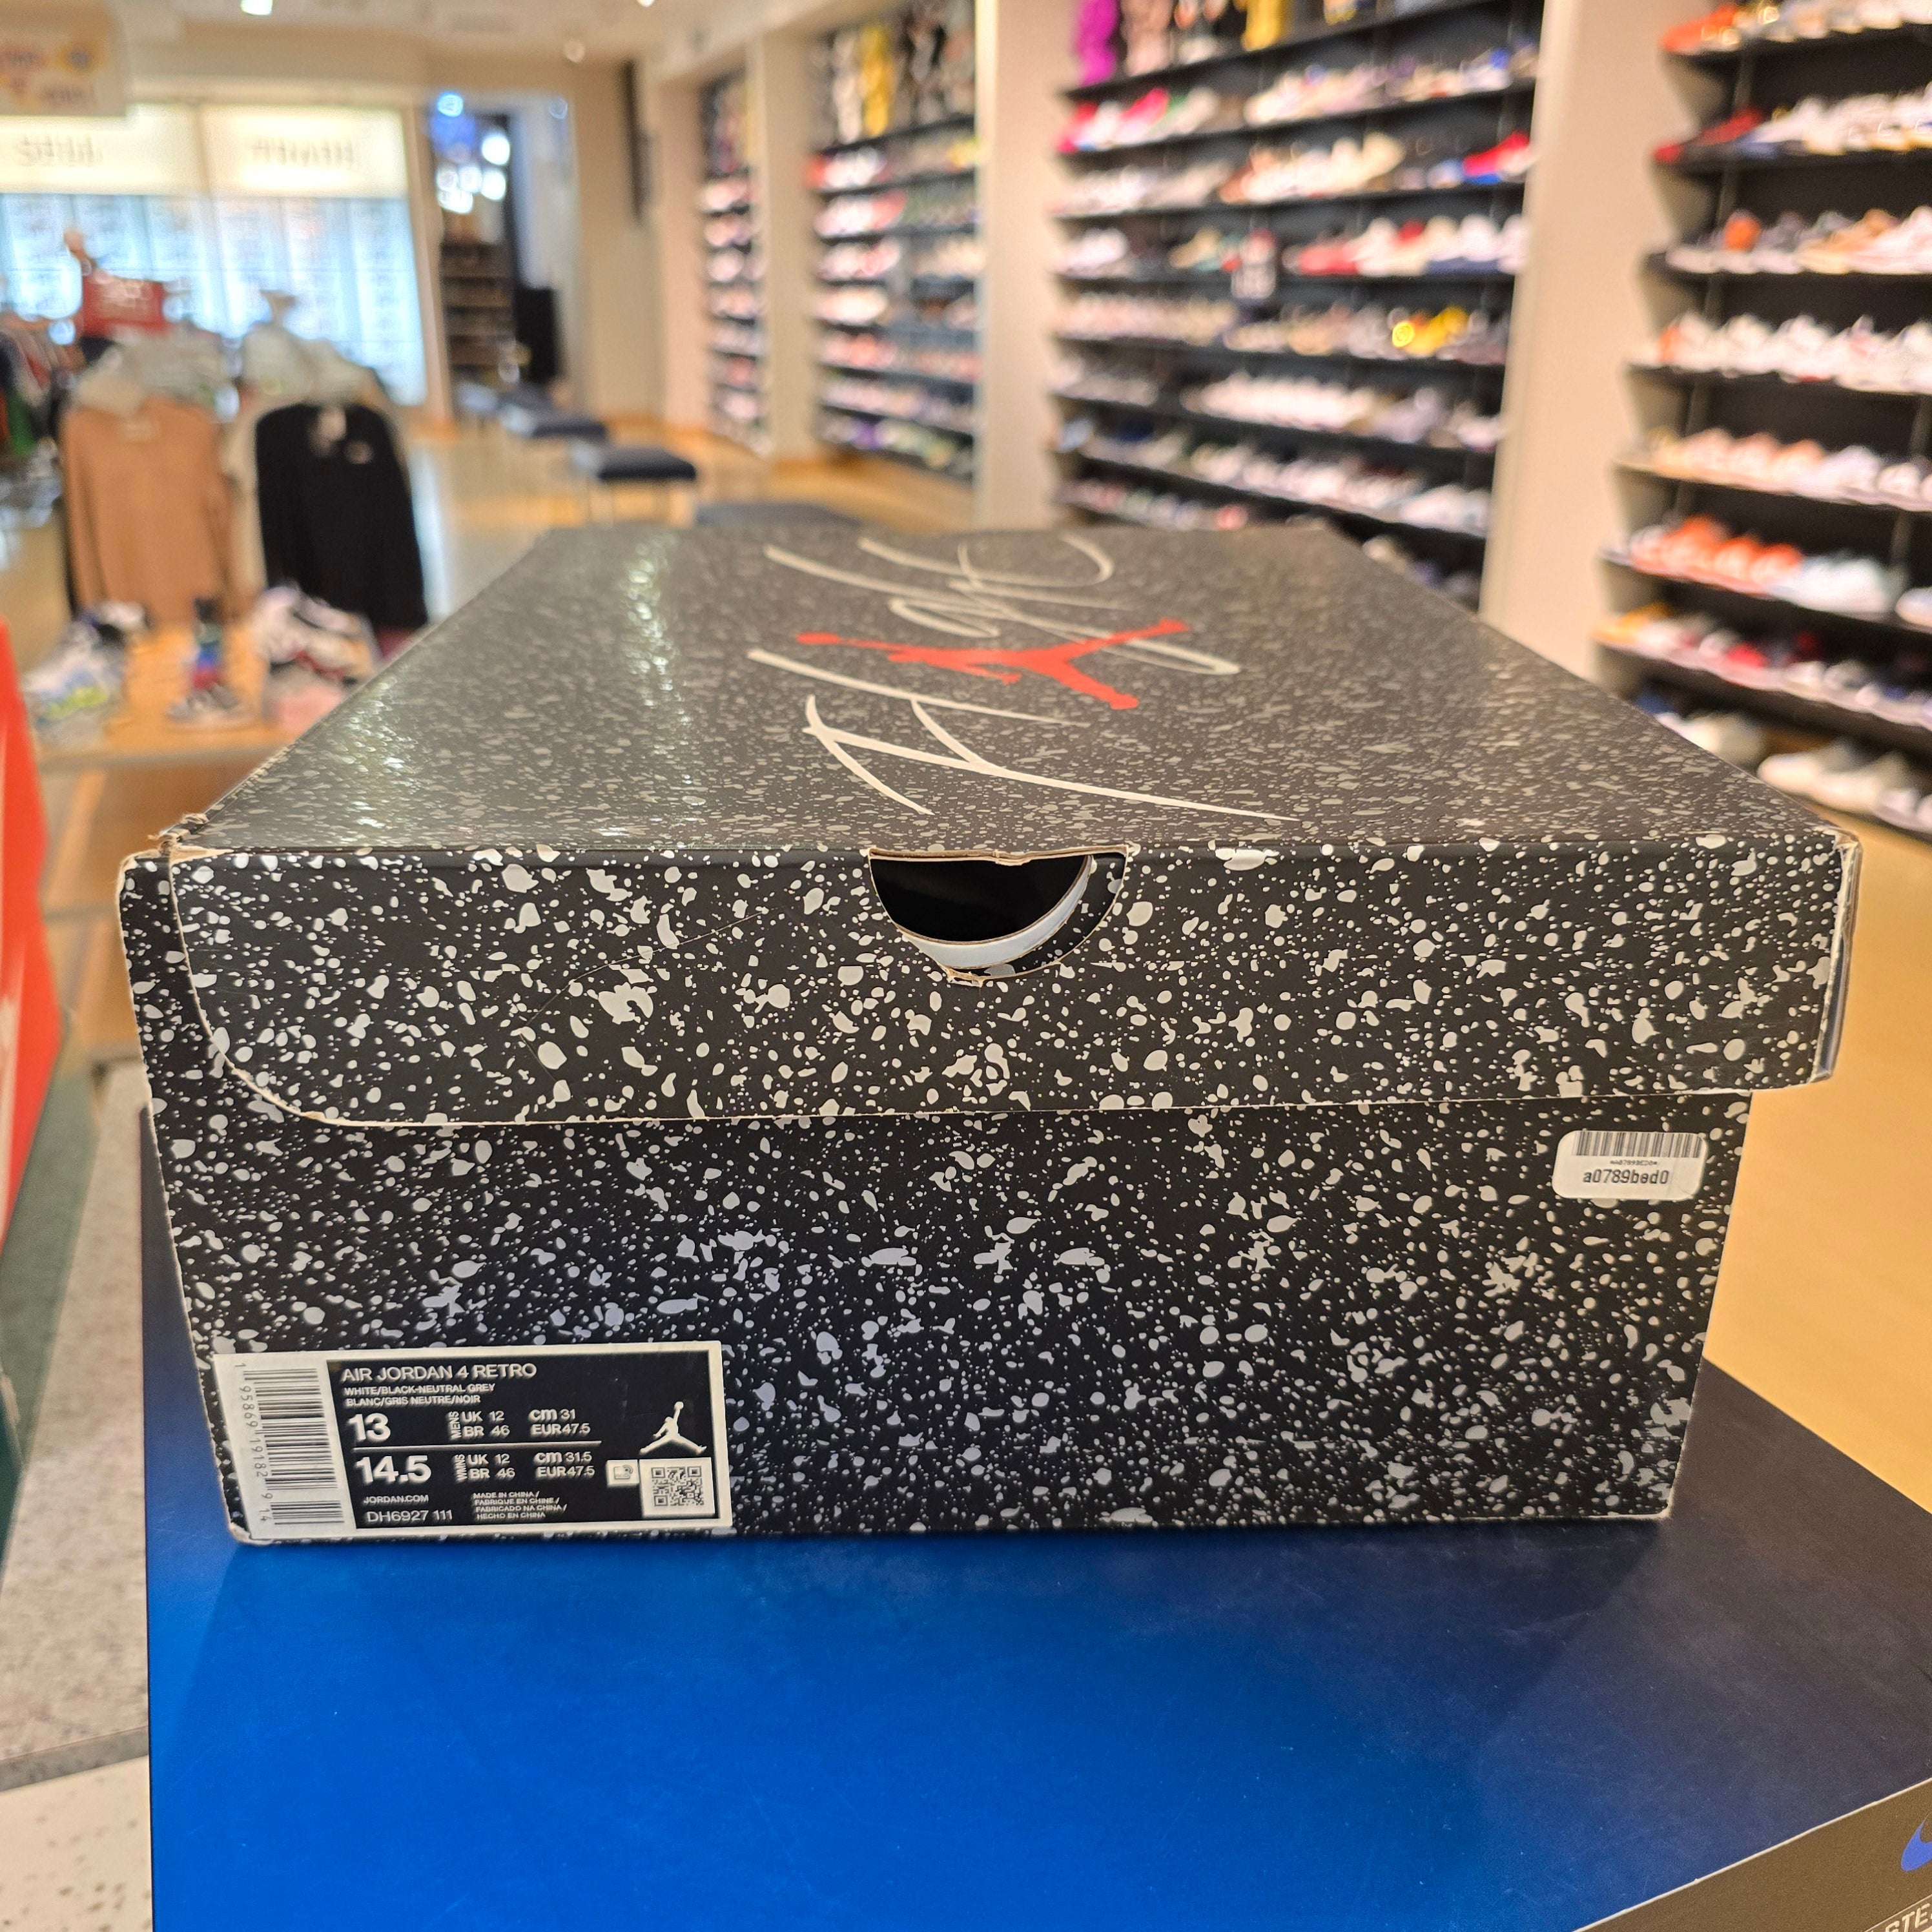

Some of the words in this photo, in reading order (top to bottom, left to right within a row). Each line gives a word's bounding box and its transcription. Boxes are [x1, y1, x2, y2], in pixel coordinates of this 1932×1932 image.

[1583, 1169, 1669, 1184] a0789bed0
[341, 1367, 373, 1382] AIR
[376, 1366, 452, 1381] JORDAN
[455, 1365, 469, 1379] 4
[472, 1363, 537, 1379] RETRO
[344, 1384, 466, 1396] WHITE/BLACK-NEUTRAL
[466, 1383, 495, 1393] GREY
[345, 1397, 408, 1407] BLANC/GRIS
[410, 1395, 480, 1405] NEUTRE/NOIR
[460, 1411, 483, 1423] UK
[489, 1410, 505, 1422] 12
[529, 1409, 557, 1421] cm
[559, 1409, 575, 1420] 31
[347, 1413, 391, 1442] 13
[448, 1411, 462, 1440] MENS
[462, 1426, 484, 1438] BR
[489, 1425, 510, 1437] 46
[240, 1386, 258, 1427] 95869
[249, 1438, 268, 1477] 19182
[259, 1508, 272, 1521] 14
[467, 1454, 489, 1465] UK
[495, 1454, 510, 1464] 12
[535, 1452, 562, 1463] cm
[565, 1452, 592, 1462] 31.5
[354, 1455, 431, 1484] 14.5
[455, 1454, 468, 1483] WMNS
[469, 1468, 490, 1479] BR
[497, 1468, 515, 1478] 46
[364, 1495, 429, 1505] JORDAN.COM
[366, 1510, 429, 1523] DH6927
[433, 1510, 452, 1521] 111
